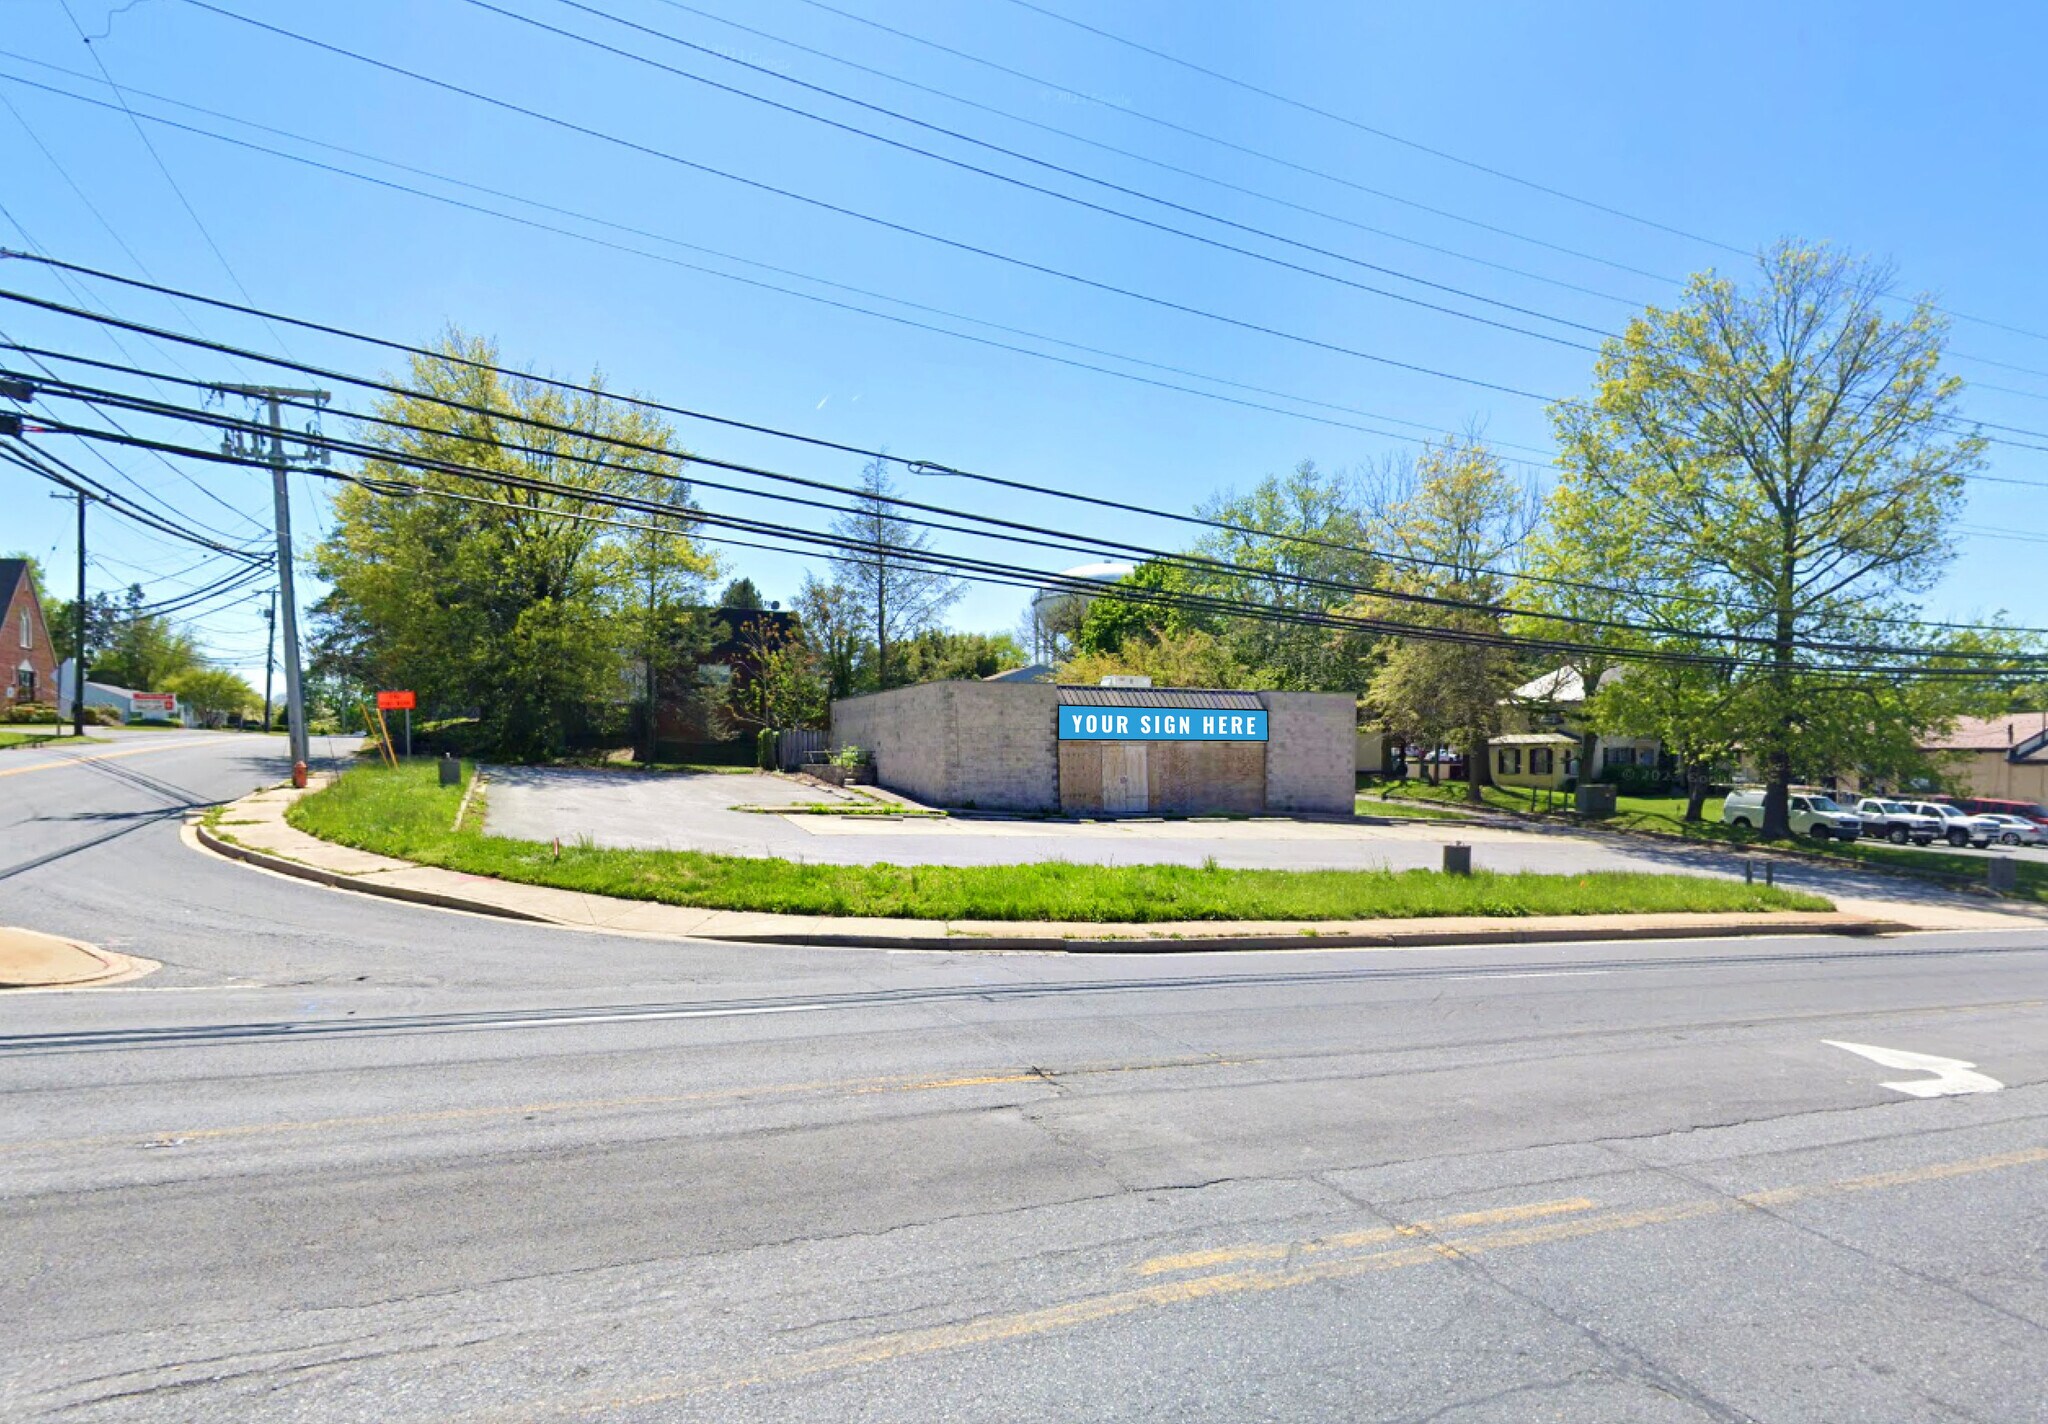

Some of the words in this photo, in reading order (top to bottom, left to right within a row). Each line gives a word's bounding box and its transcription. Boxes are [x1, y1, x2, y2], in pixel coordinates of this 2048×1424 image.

[1071, 714, 1129, 734] YOUR
[1140, 715, 1190, 735] SIGN
[1202, 716, 1257, 735] HERE
